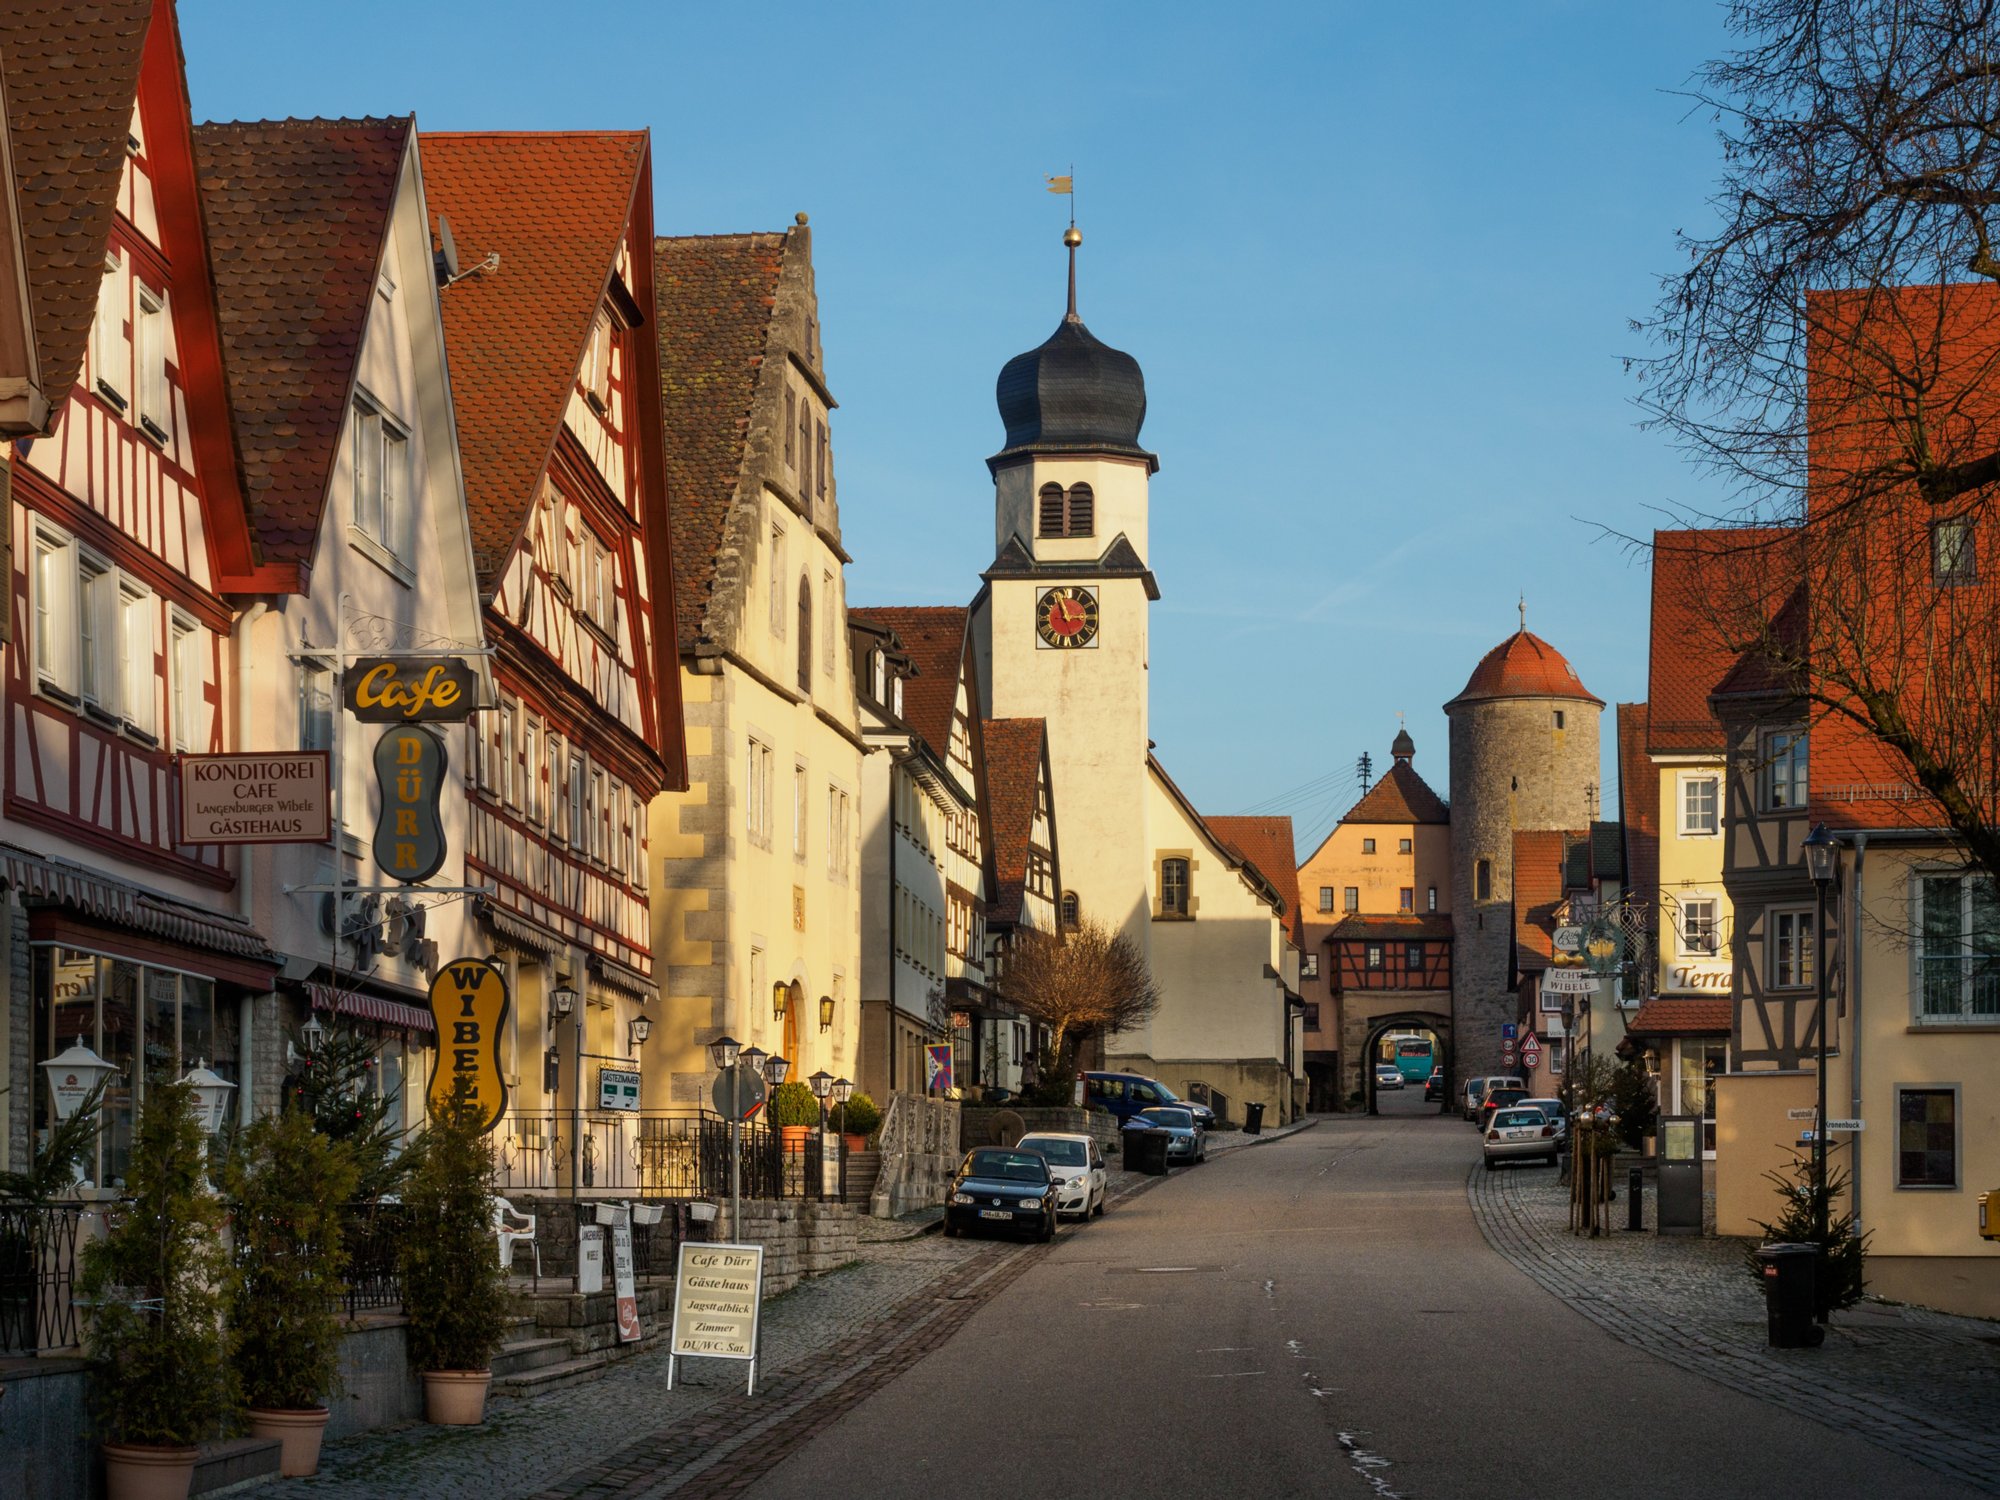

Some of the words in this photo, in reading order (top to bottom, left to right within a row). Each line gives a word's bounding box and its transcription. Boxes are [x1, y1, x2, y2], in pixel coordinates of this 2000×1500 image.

[356, 663, 461, 717] Cafe
[195, 762, 314, 781] KONDITOREI
[233, 783, 278, 799] CAFE
[394, 737, 423, 869] DÜRR
[209, 819, 302, 835] GÄSTEHAUS
[1550, 981, 1591, 992] WIBELE
[1527, 1056, 1537, 1064] 30
[603, 1072, 639, 1085] GÄSTEZIMMER
[691, 1255, 719, 1268] Cafe
[723, 1255, 753, 1267] Dürr
[687, 1301, 750, 1314] Jagsttalblick
[694, 1322, 735, 1333] Zimmer
[726, 1343, 745, 1353] Sat.
